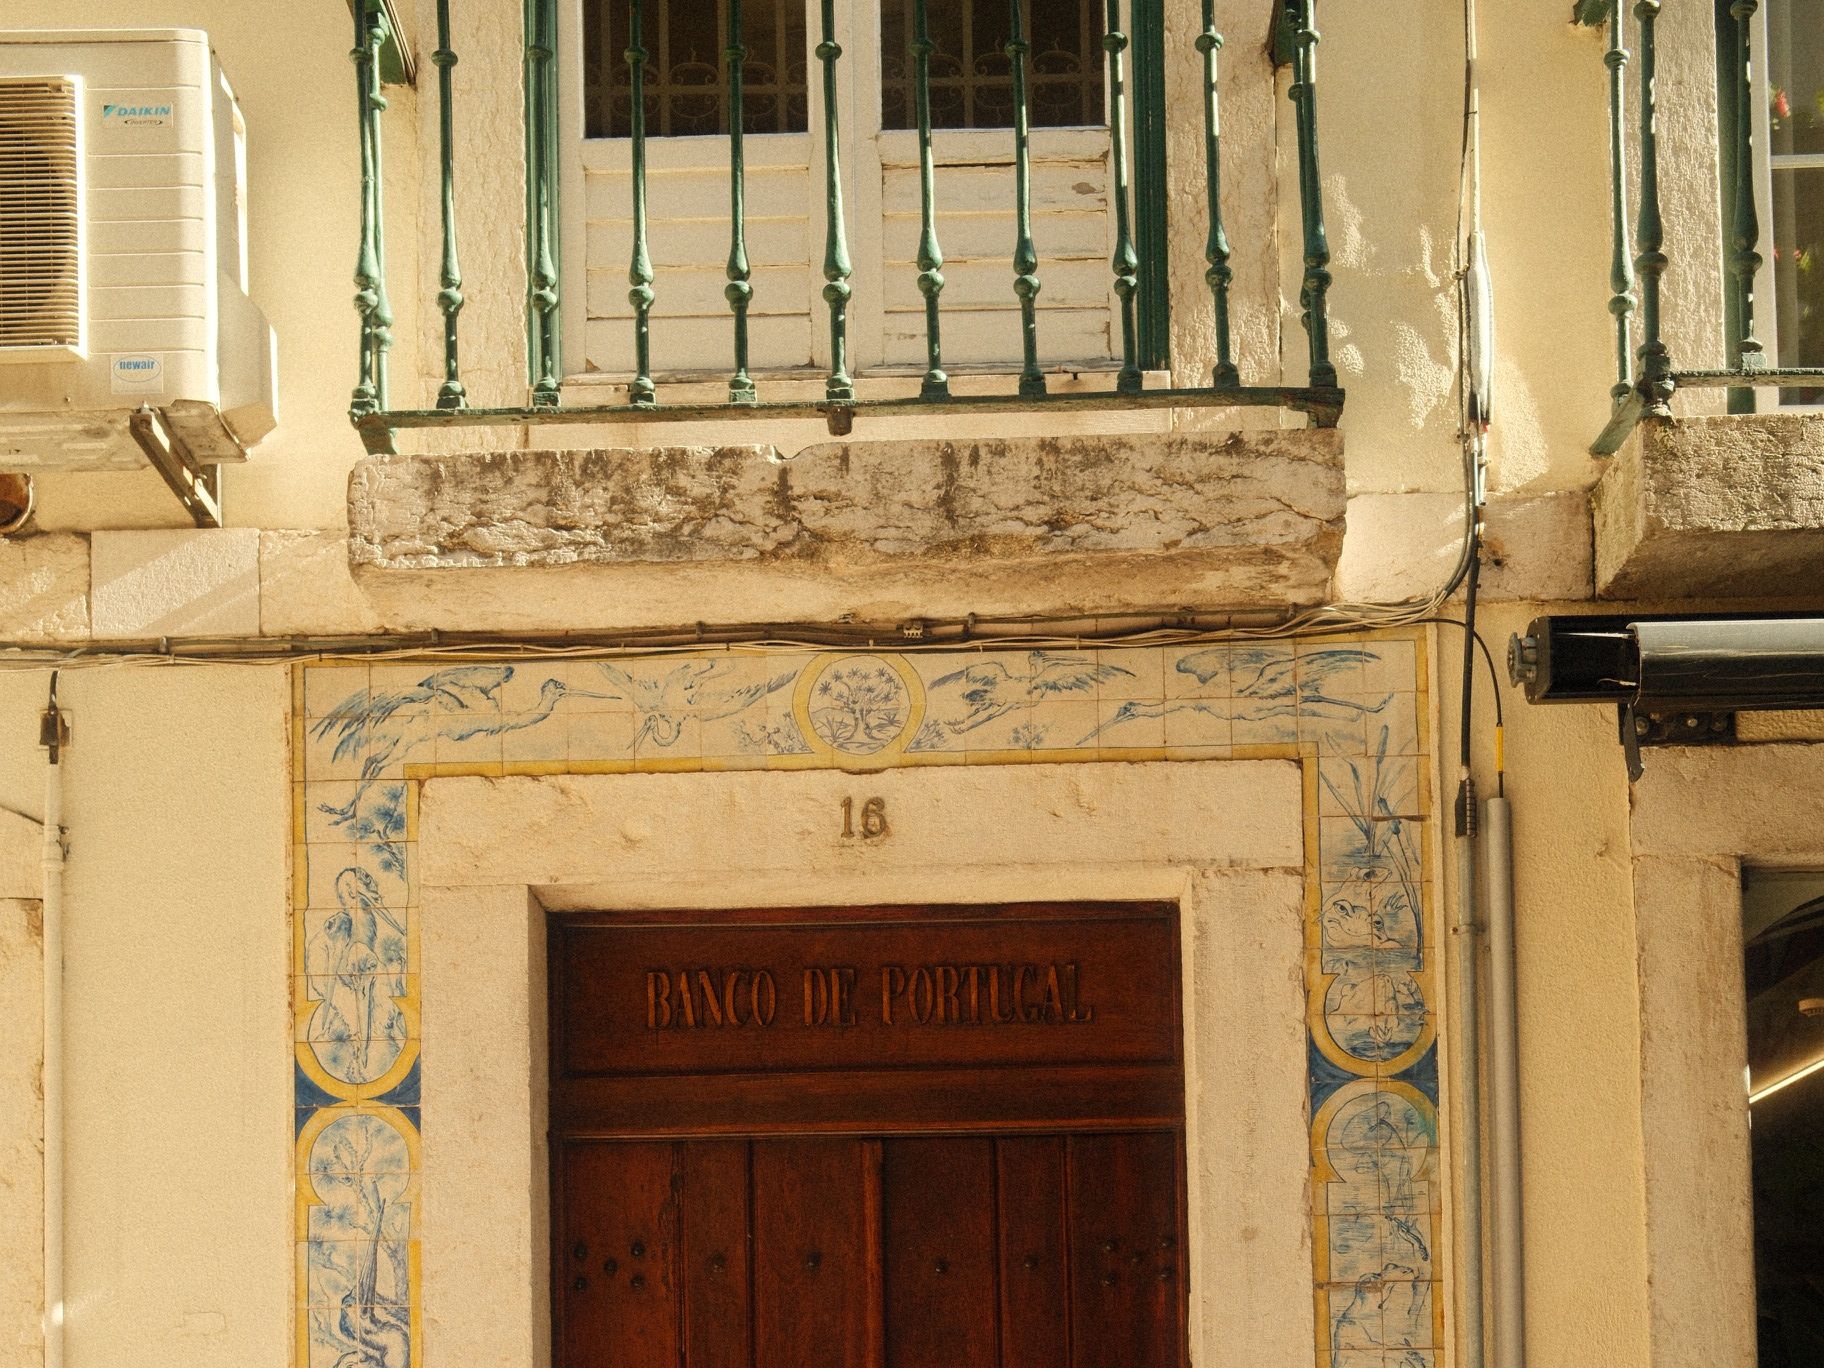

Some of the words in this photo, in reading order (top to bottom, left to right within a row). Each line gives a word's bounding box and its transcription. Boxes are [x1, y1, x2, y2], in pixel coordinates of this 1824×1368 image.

[118, 106, 170, 116] DAIKIN
[119, 360, 155, 370] newair
[840, 796, 886, 839] 16
[646, 971, 777, 1028] BANCO
[803, 967, 857, 1026] DE
[882, 963, 1095, 1026] PORTUGAL
